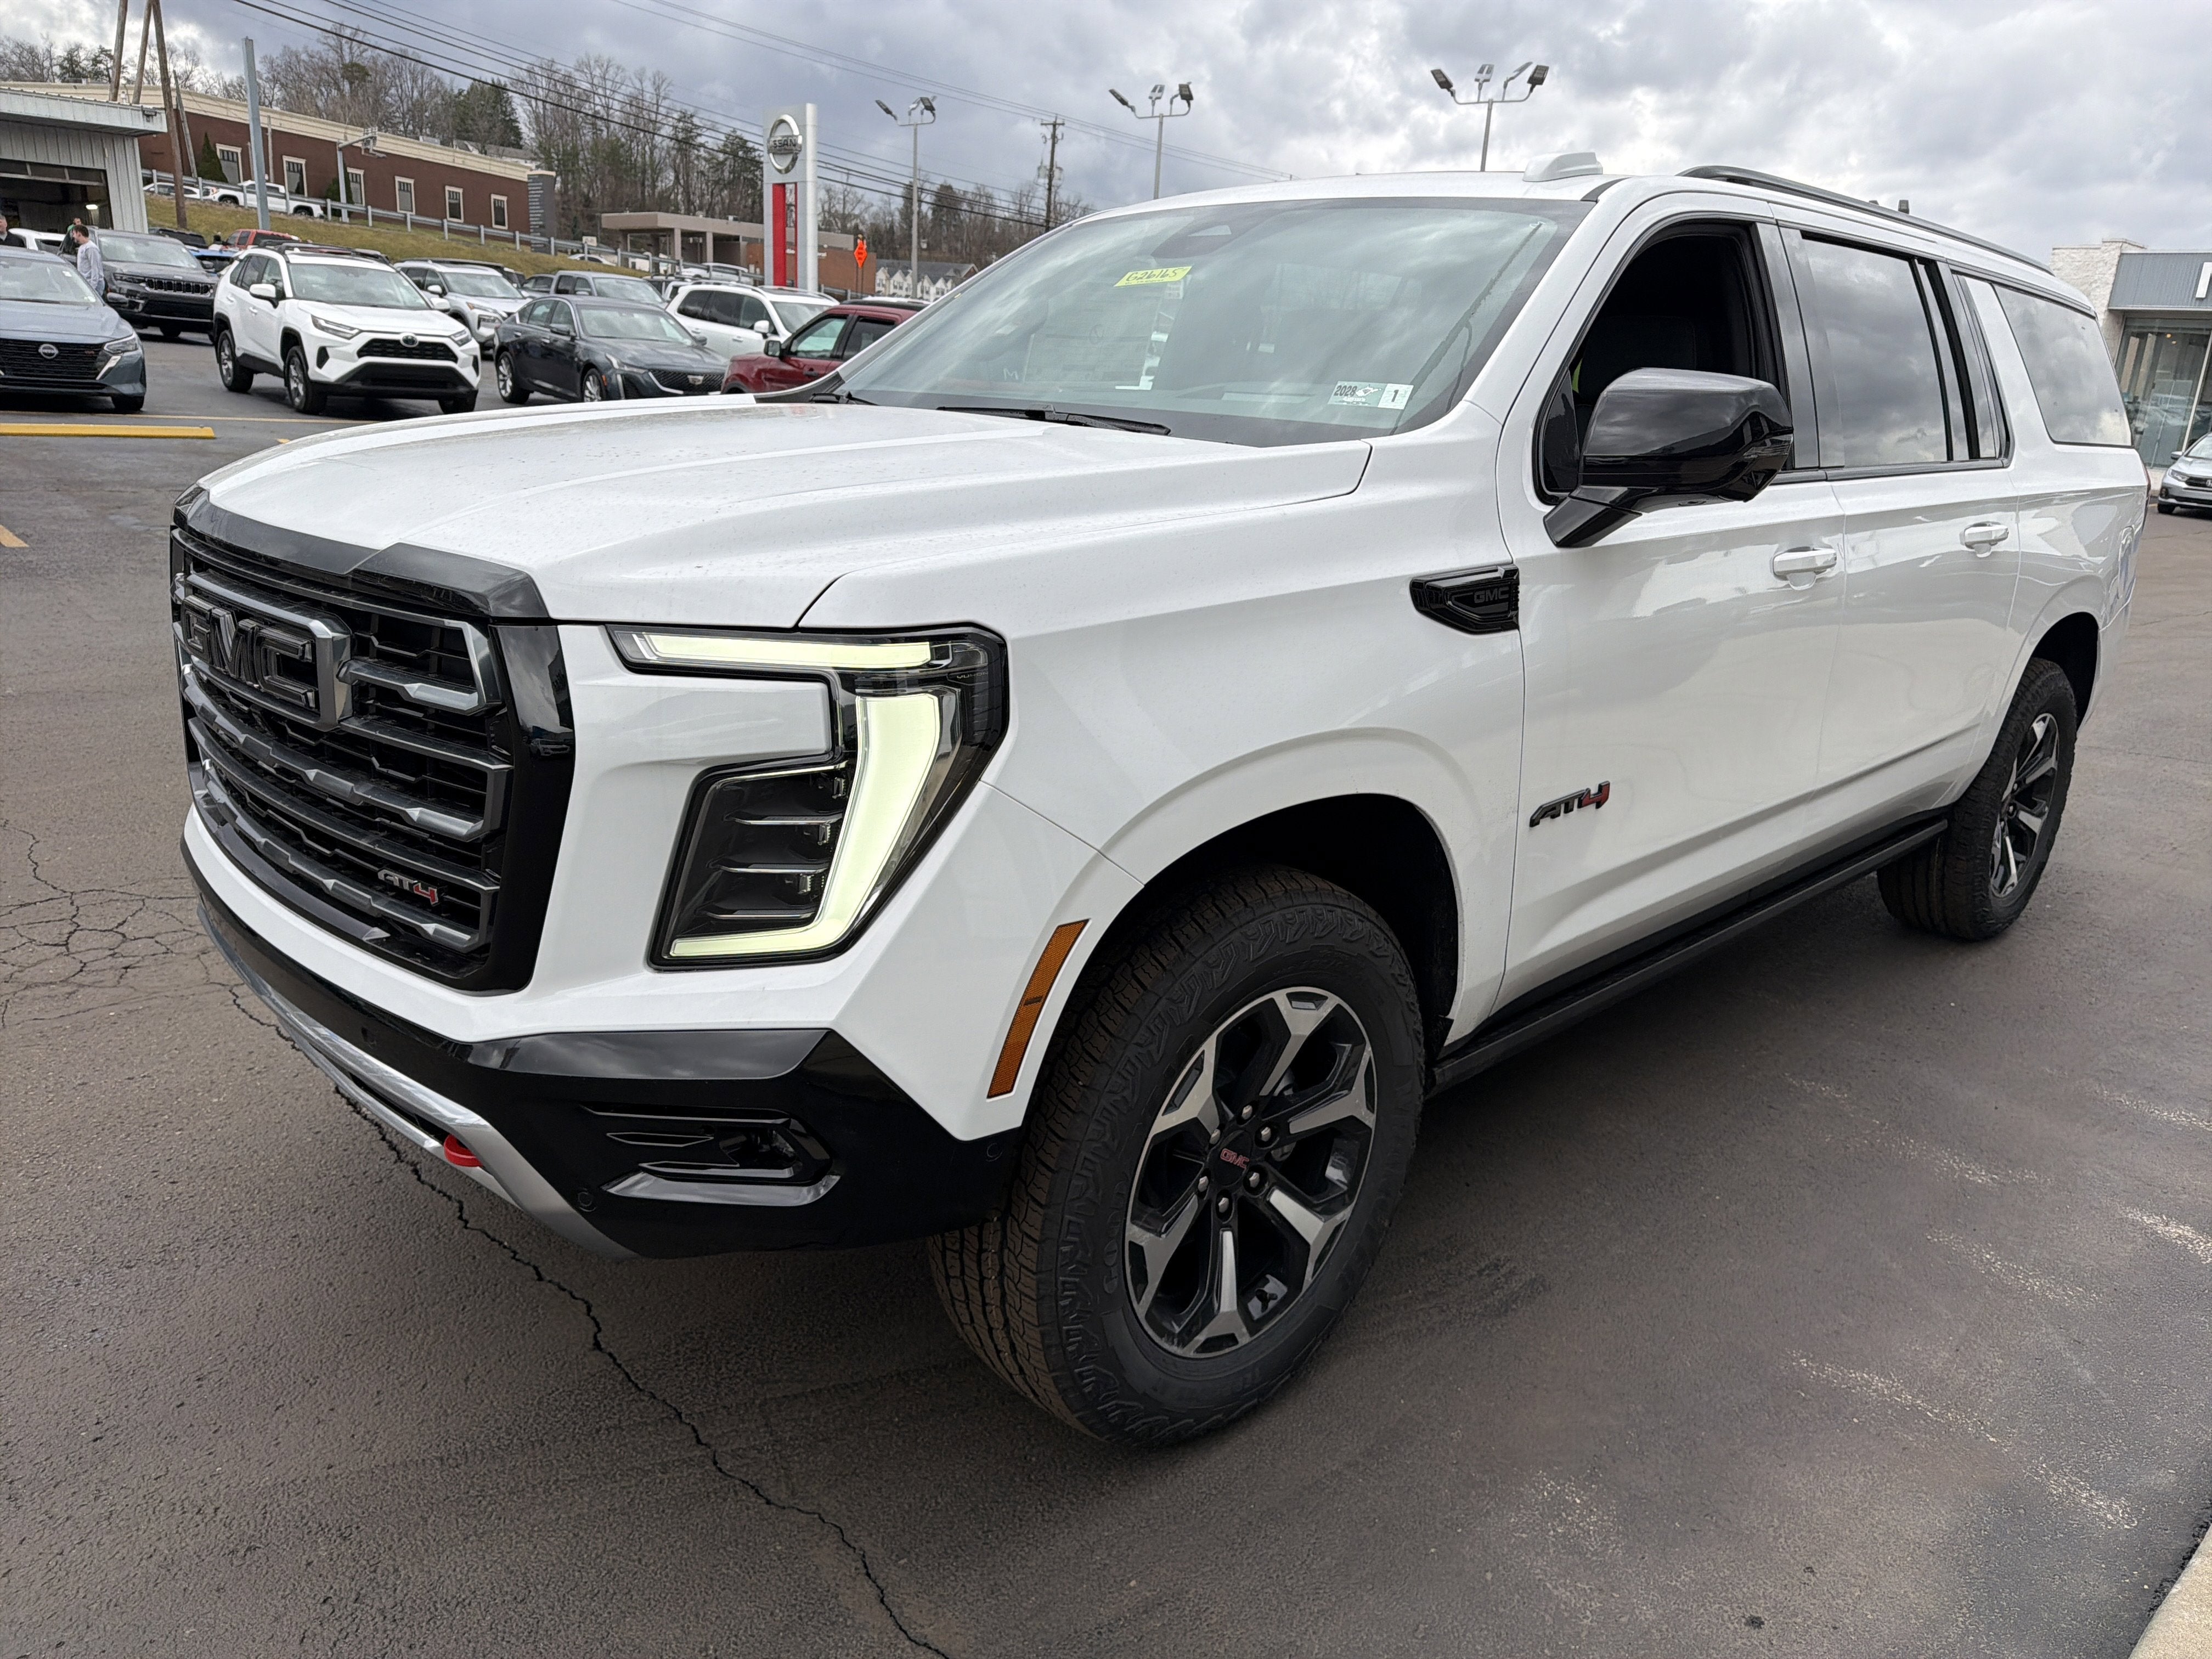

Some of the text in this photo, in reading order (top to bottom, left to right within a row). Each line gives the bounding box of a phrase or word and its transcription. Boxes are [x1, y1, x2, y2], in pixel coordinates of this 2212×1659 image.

[1333, 385, 1358, 397] 2028
[1391, 389, 1399, 403] 1
[1474, 586, 1510, 603] GMC
[180, 595, 318, 711] GMC
[1530, 781, 1610, 827] AT4
[377, 869, 439, 906] AT4
[1220, 1148, 1250, 1170] GMC
